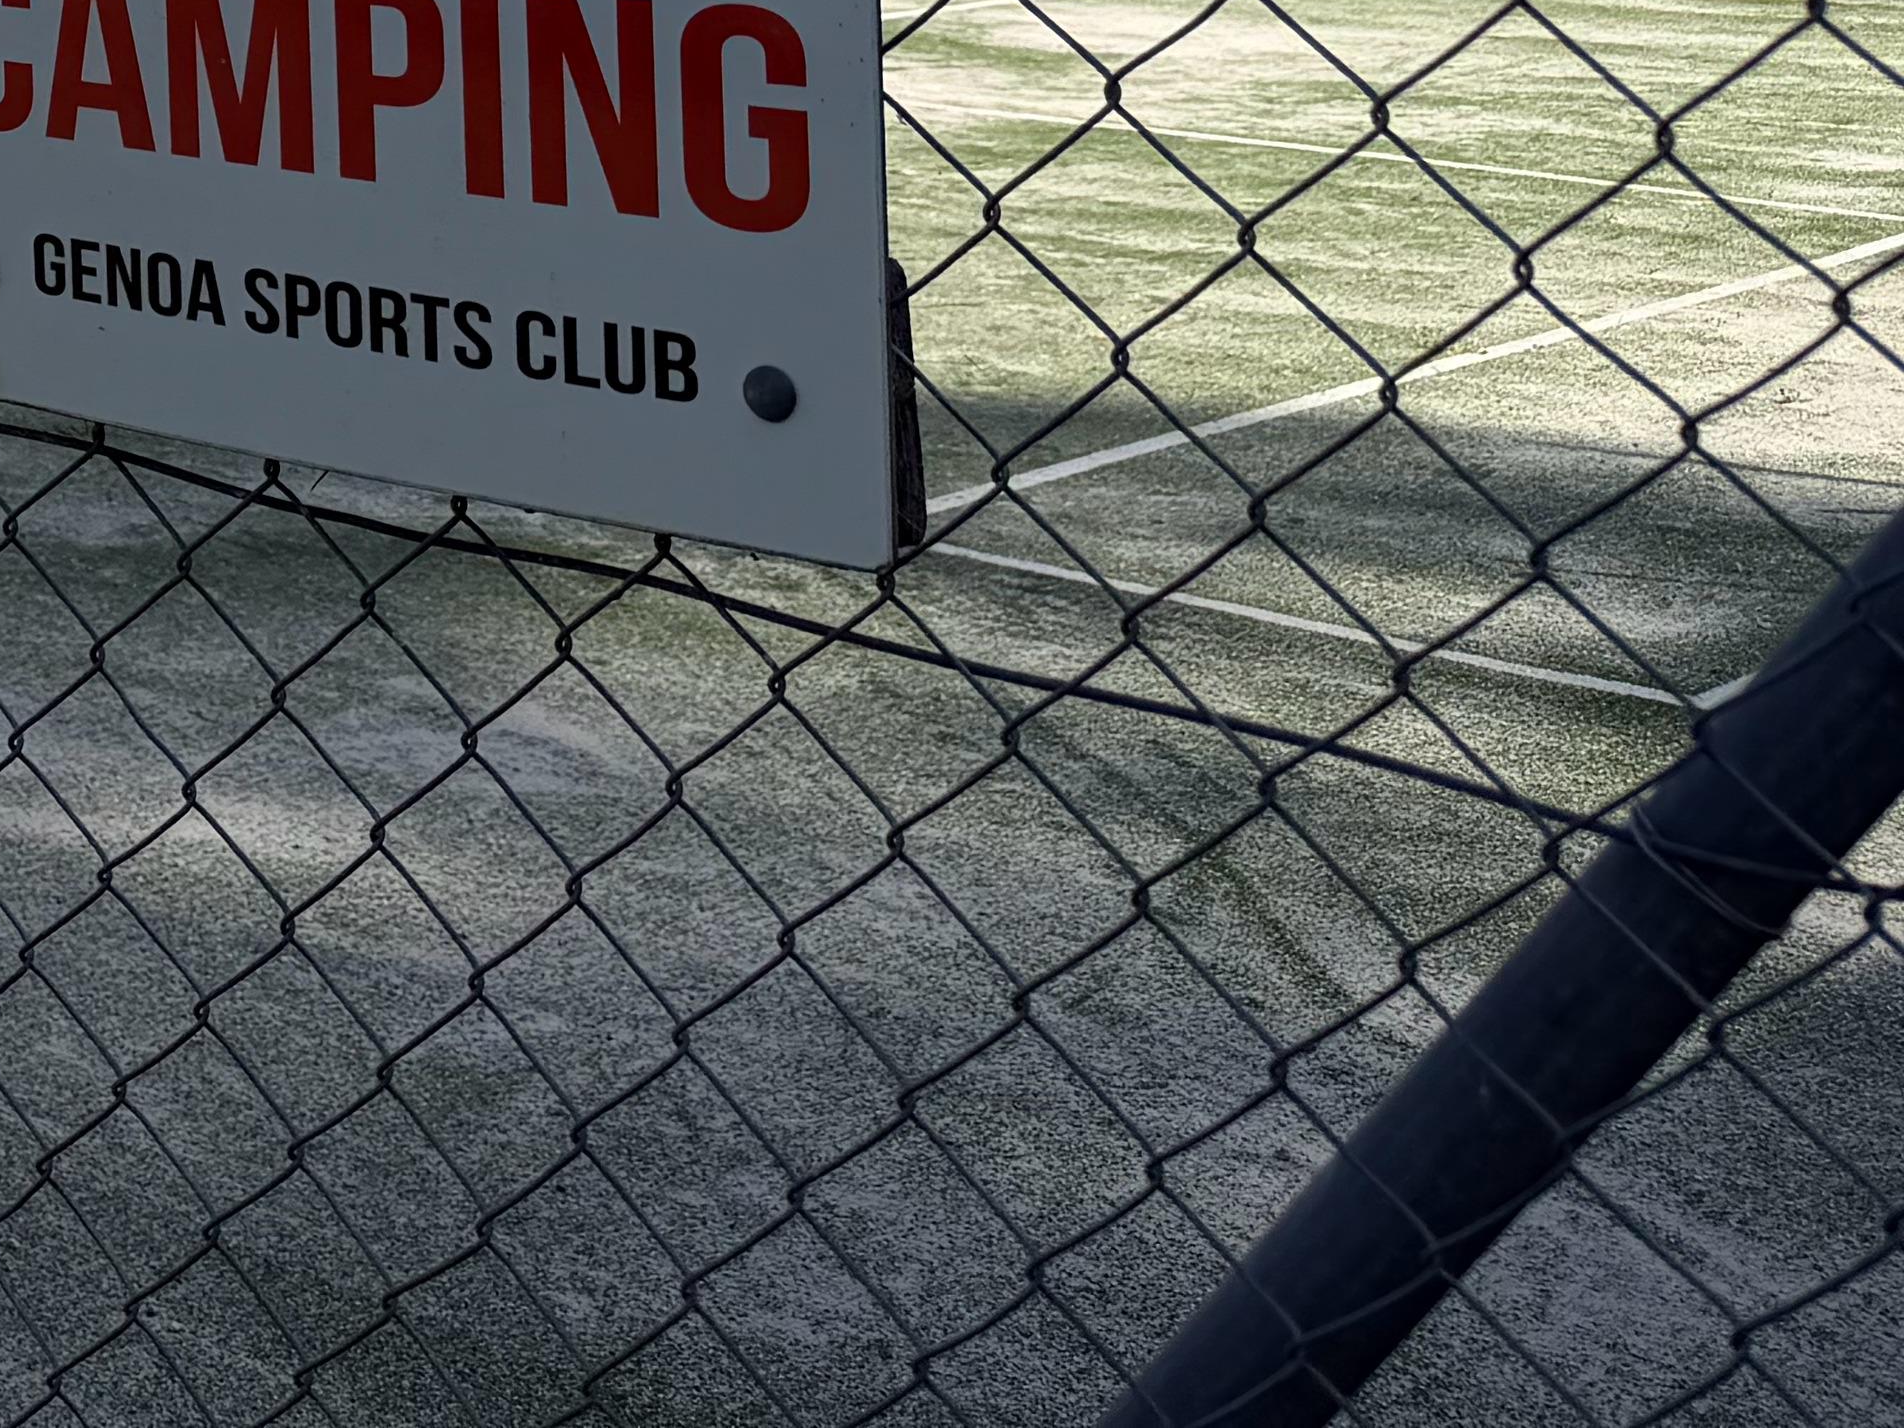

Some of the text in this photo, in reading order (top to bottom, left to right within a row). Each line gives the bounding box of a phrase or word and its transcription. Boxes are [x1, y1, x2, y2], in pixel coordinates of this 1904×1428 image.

[32, 231, 700, 404] GENOA SPORTS CLUB
